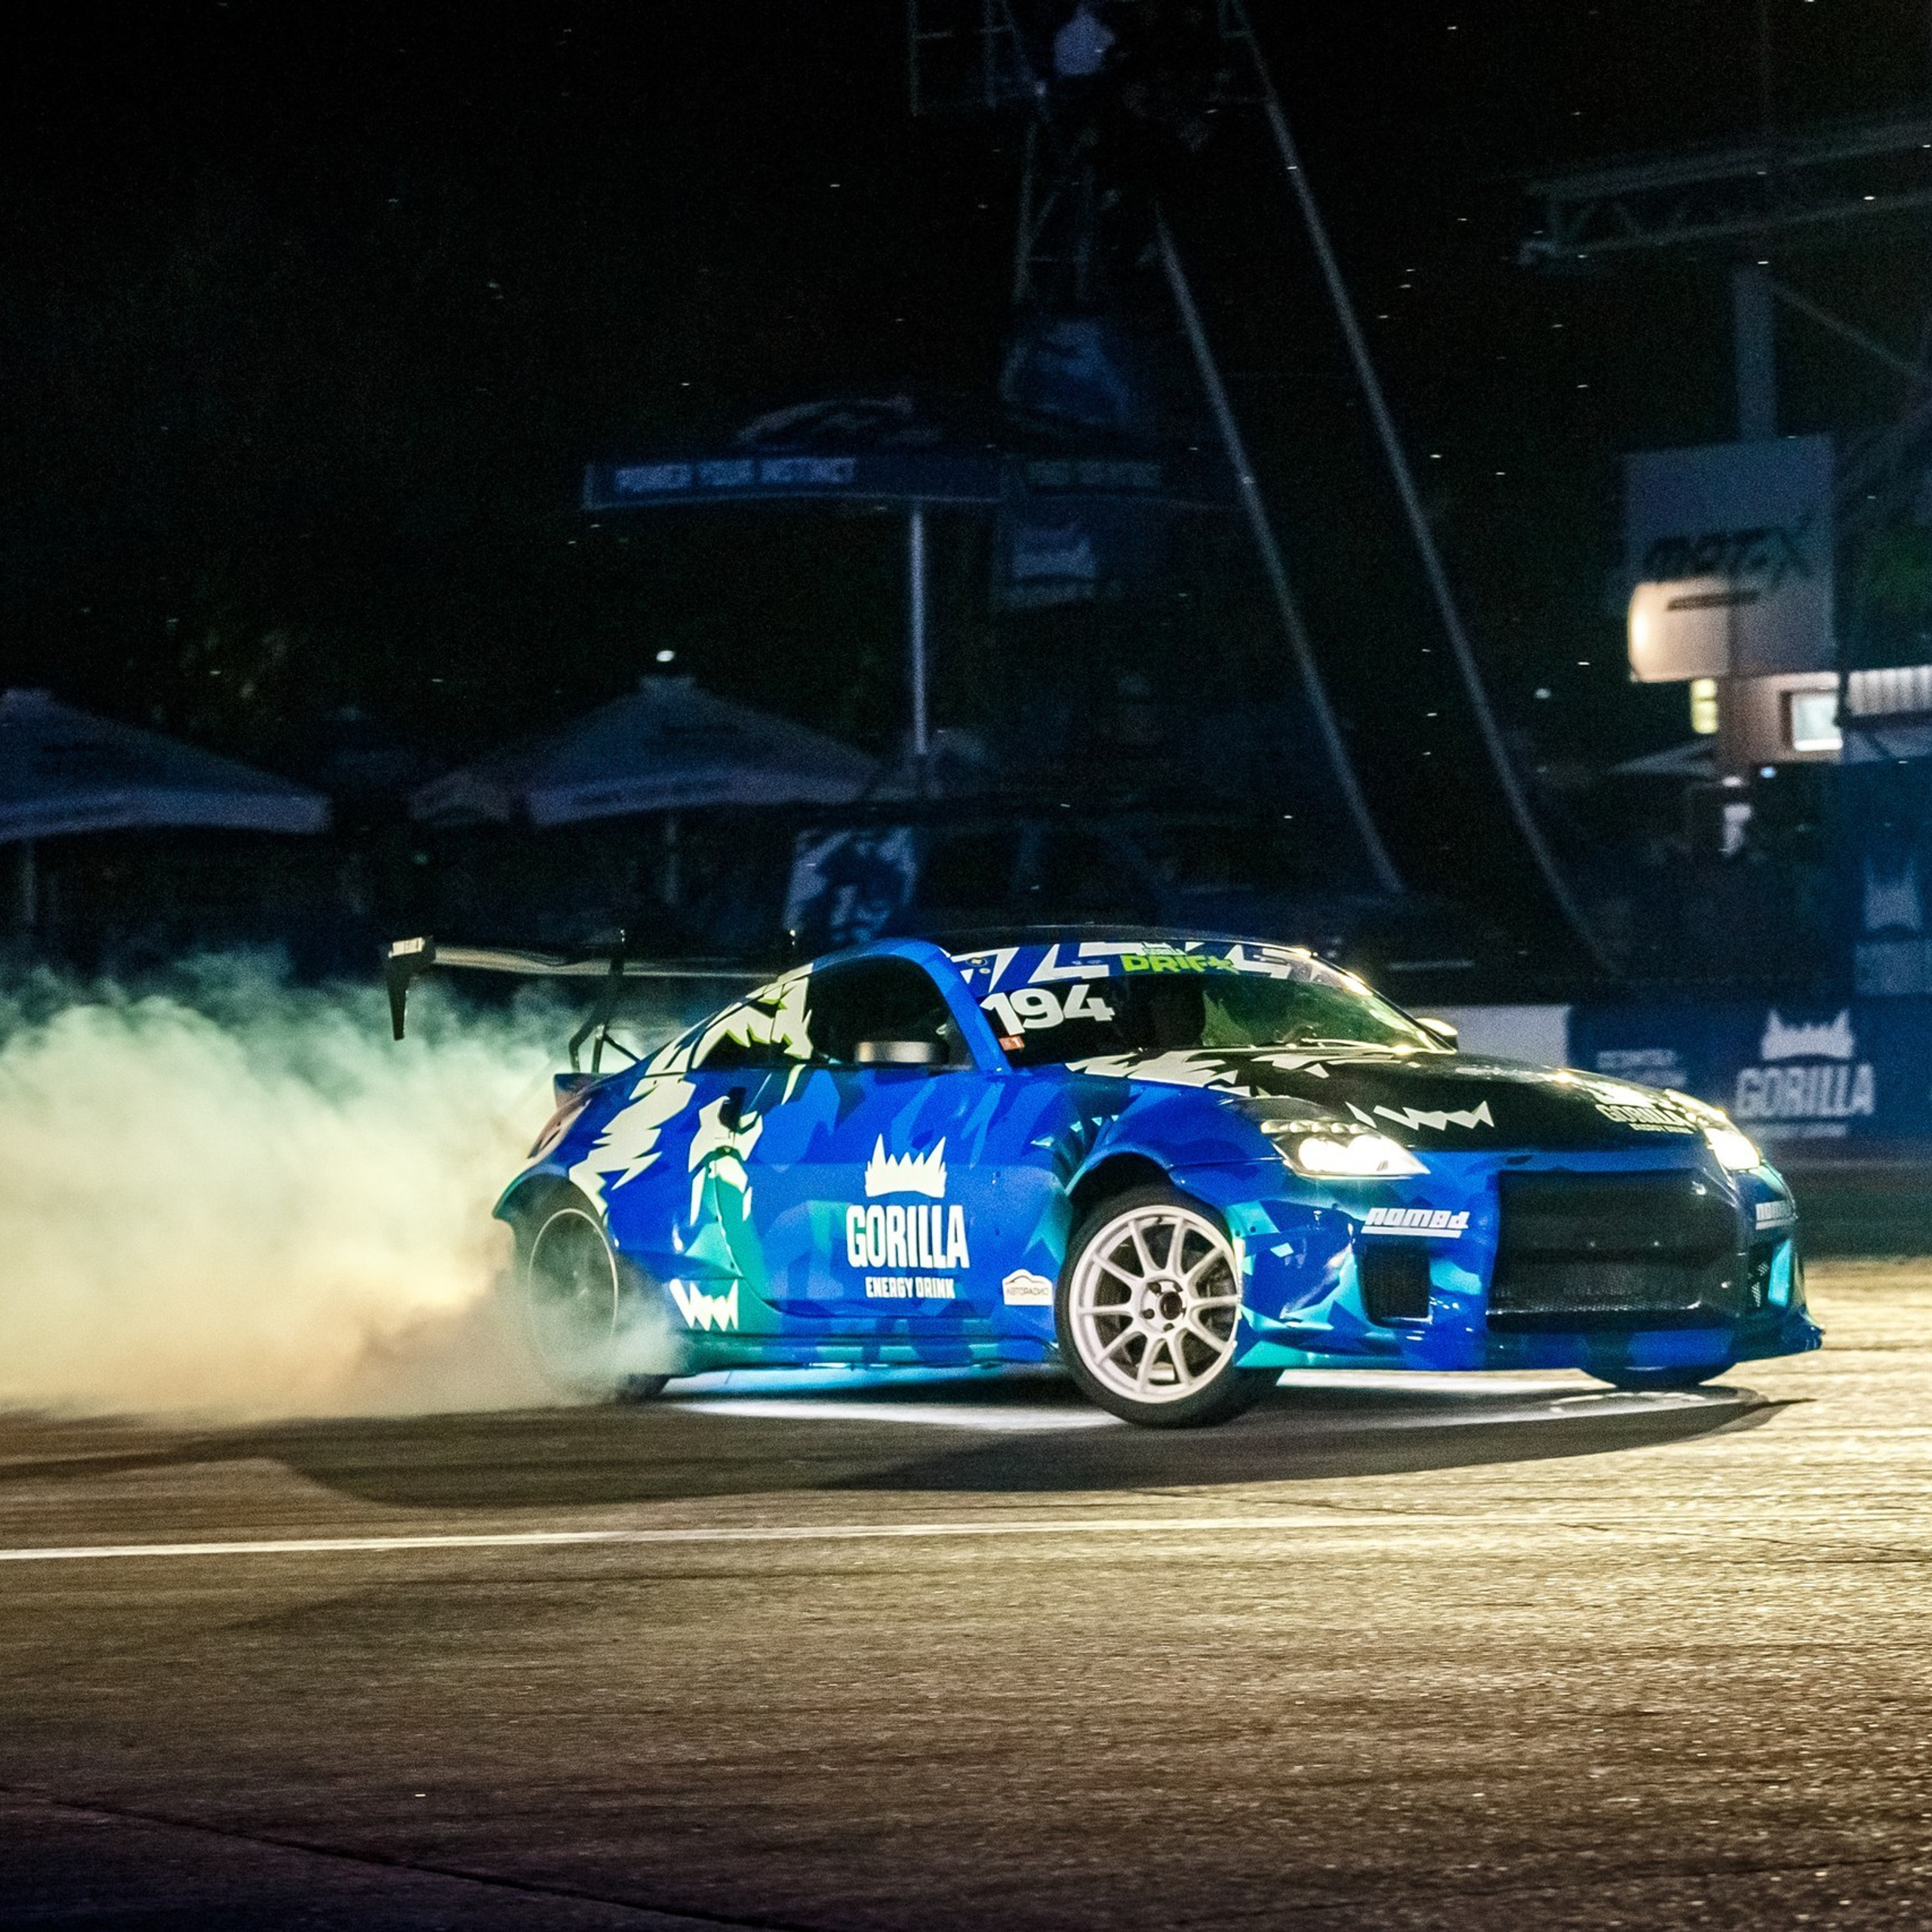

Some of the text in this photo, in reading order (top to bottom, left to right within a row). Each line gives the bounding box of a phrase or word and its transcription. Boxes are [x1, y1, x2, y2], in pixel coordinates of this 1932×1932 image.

[980, 984, 1115, 1035] 194
[1736, 1063, 1875, 1118] GORILLA
[846, 1204, 970, 1269] GORILLA
[866, 1276, 955, 1300] ENERGY DRINK
